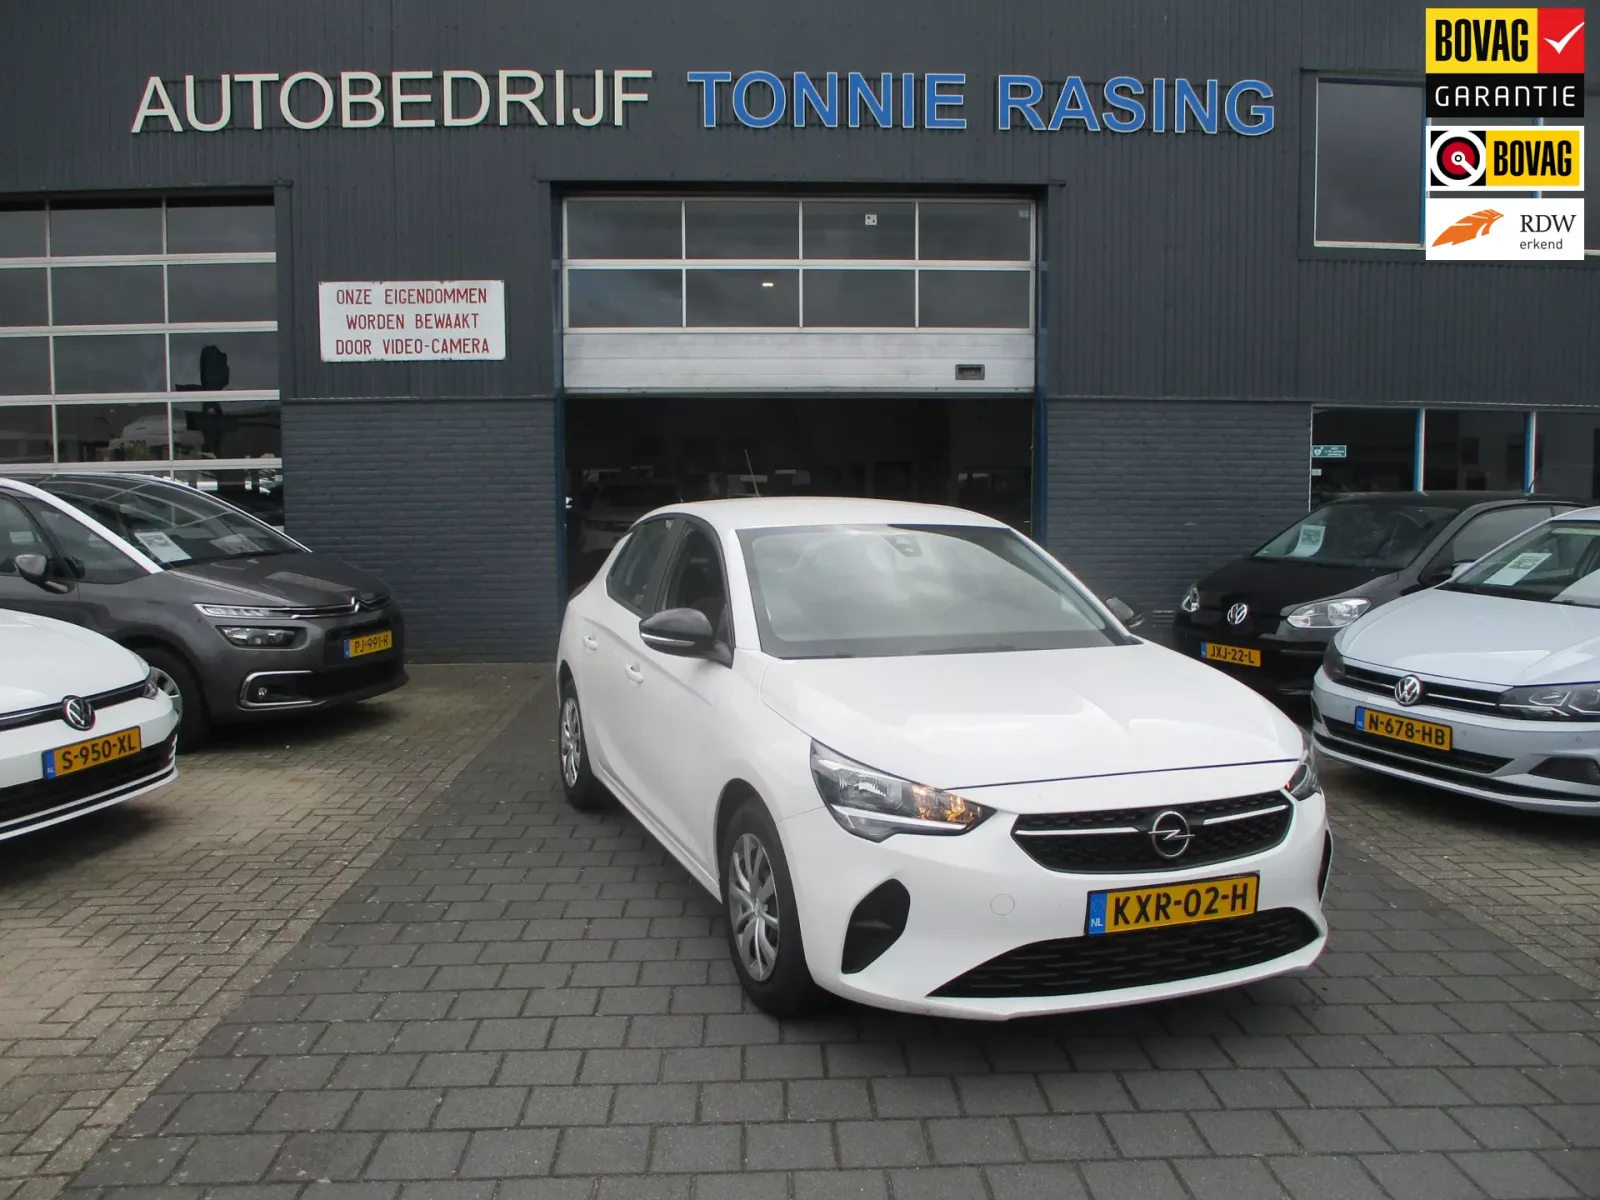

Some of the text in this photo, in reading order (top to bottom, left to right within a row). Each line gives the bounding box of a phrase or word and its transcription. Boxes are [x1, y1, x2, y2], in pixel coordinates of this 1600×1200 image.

[131, 69, 1275, 136] AUTOBEDRIJF TONNIE RASING
[336, 288, 488, 305] ONZE EIGENDOMMEN
[346, 313, 479, 330] WORDEN BEWAAKT
[336, 338, 489, 355] DOOR VIDEO-CAMERA
[1210, 645, 1255, 664] JXJ-22-L
[1368, 713, 1446, 746] N-678-HB
[62, 733, 136, 770] S-950-XL
[1090, 882, 1249, 928] NL KXR-02-H
